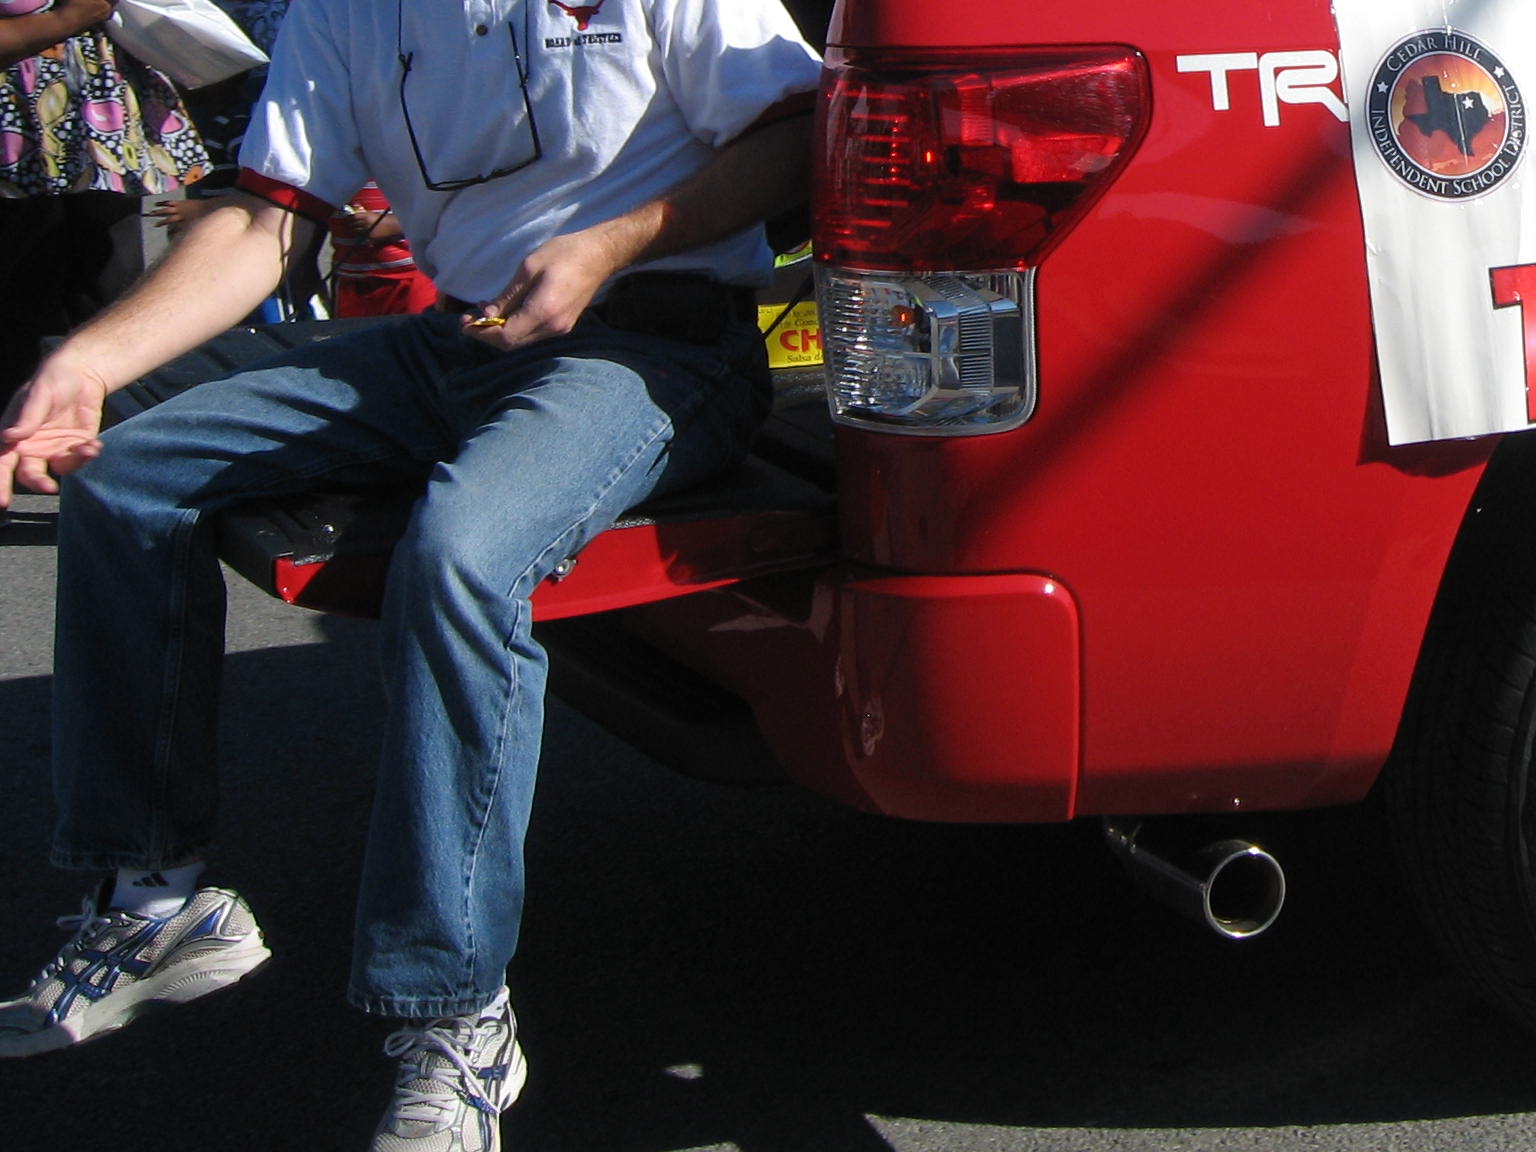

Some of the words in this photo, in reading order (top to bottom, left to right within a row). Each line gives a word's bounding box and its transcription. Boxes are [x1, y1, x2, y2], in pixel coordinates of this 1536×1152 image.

[1386, 37, 1438, 72] CEDAR
[1444, 35, 1481, 61] HILL
[1176, 49, 1349, 127] TR
[1371, 110, 1449, 195] INDEPENDENT
[1453, 160, 1512, 196] SCHOOL
[779, 328, 824, 353] CH
